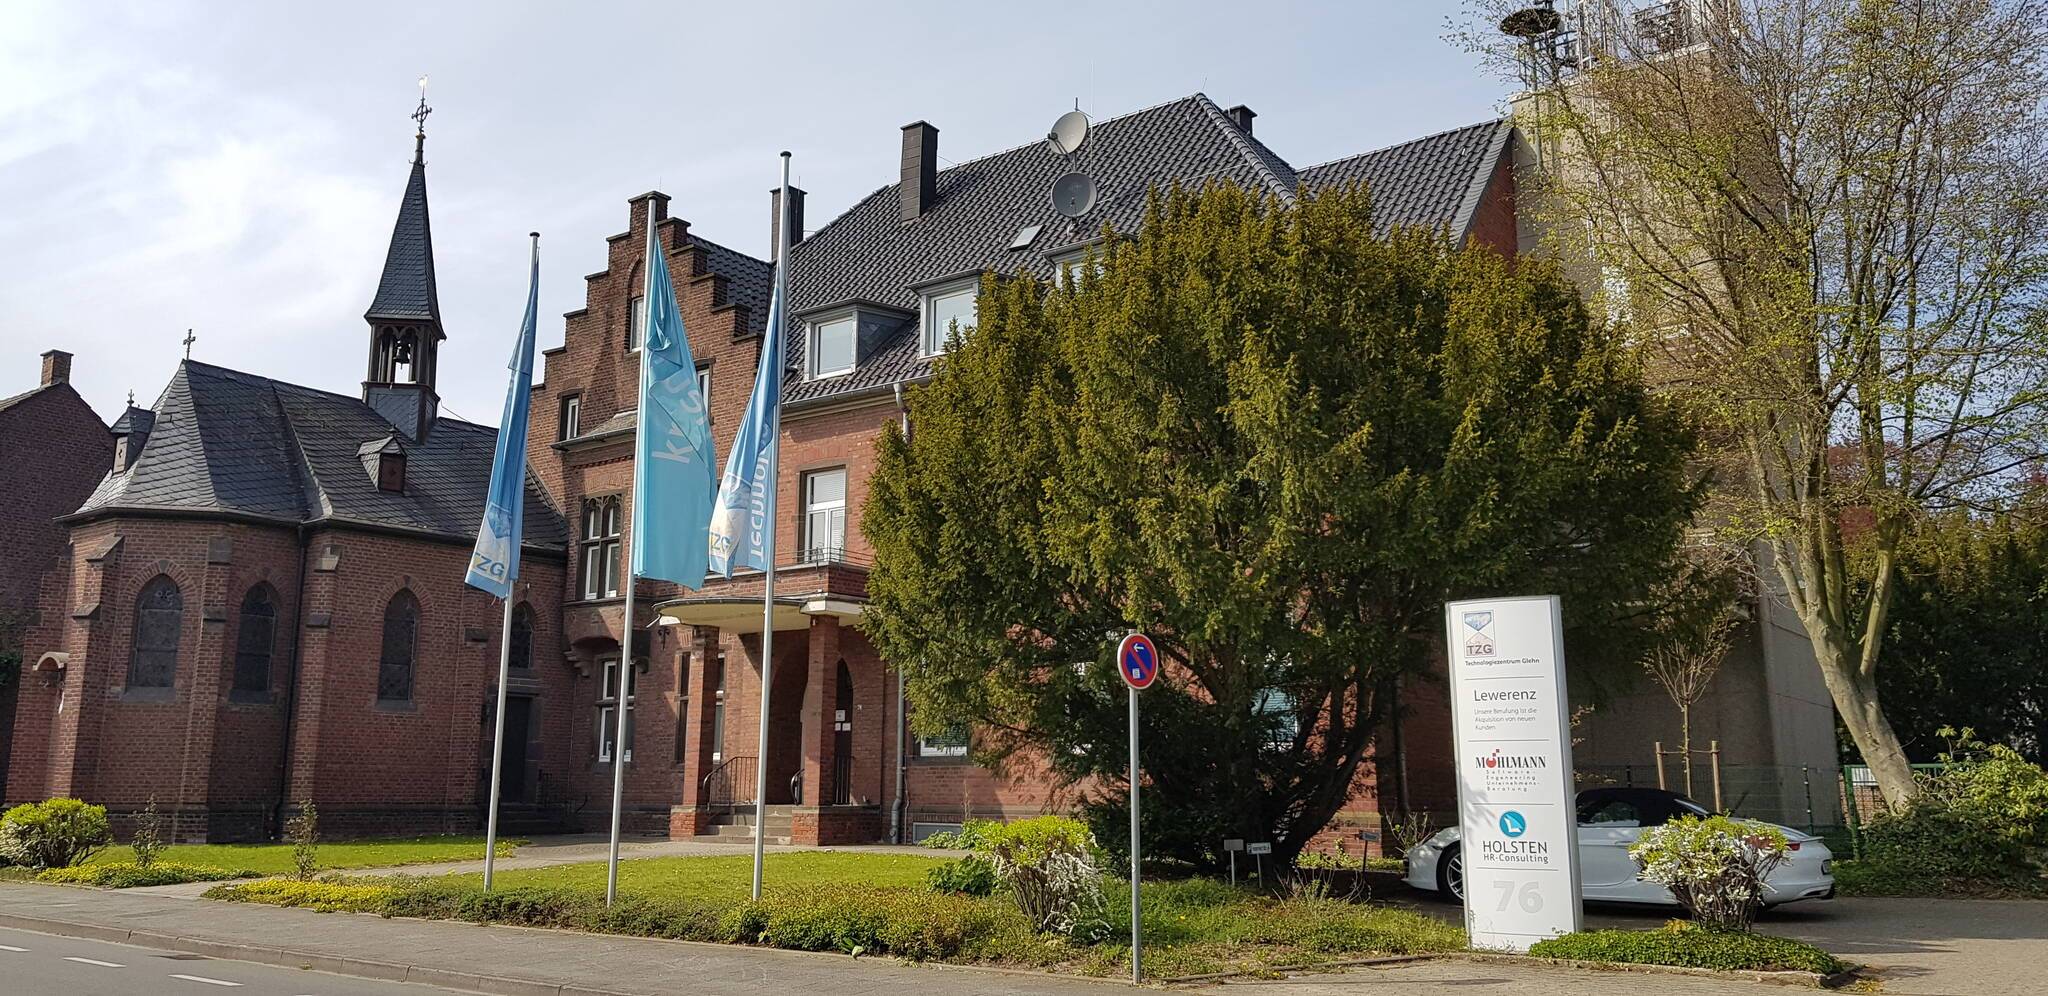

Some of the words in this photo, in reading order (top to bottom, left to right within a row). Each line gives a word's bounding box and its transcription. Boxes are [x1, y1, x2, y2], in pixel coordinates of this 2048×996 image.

[1466, 643, 1493, 655] TZG
[1465, 659, 1521, 667] Technologiezentrum
[1474, 689, 1537, 702] Lewerenz
[1482, 840, 1548, 854] HOLSTEN
[1483, 853, 1549, 865] HR-Consulting
[1493, 880, 1544, 914] 76
